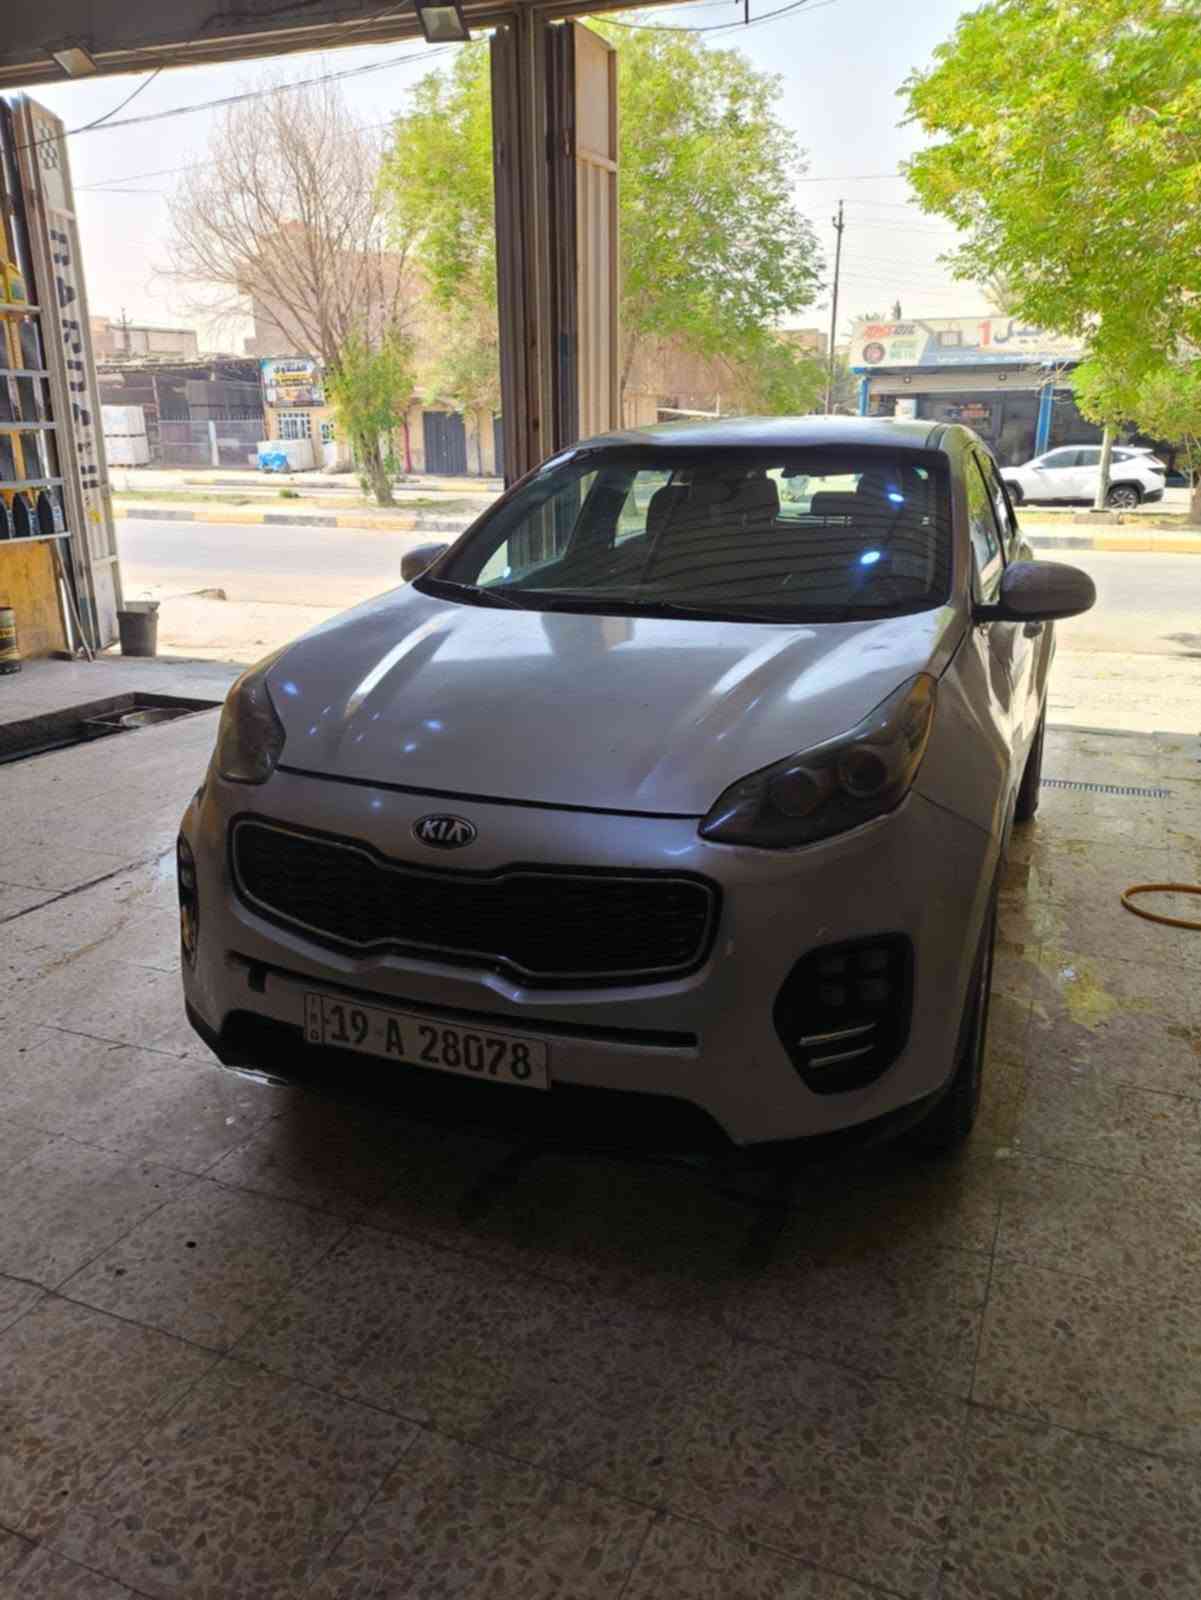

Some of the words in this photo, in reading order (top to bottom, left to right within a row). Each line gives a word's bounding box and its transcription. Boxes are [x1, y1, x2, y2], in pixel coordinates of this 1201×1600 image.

[422, 819, 469, 842] KIA
[331, 1005, 369, 1045] 19
[385, 1018, 405, 1056] A
[418, 1025, 531, 1079] 28078
